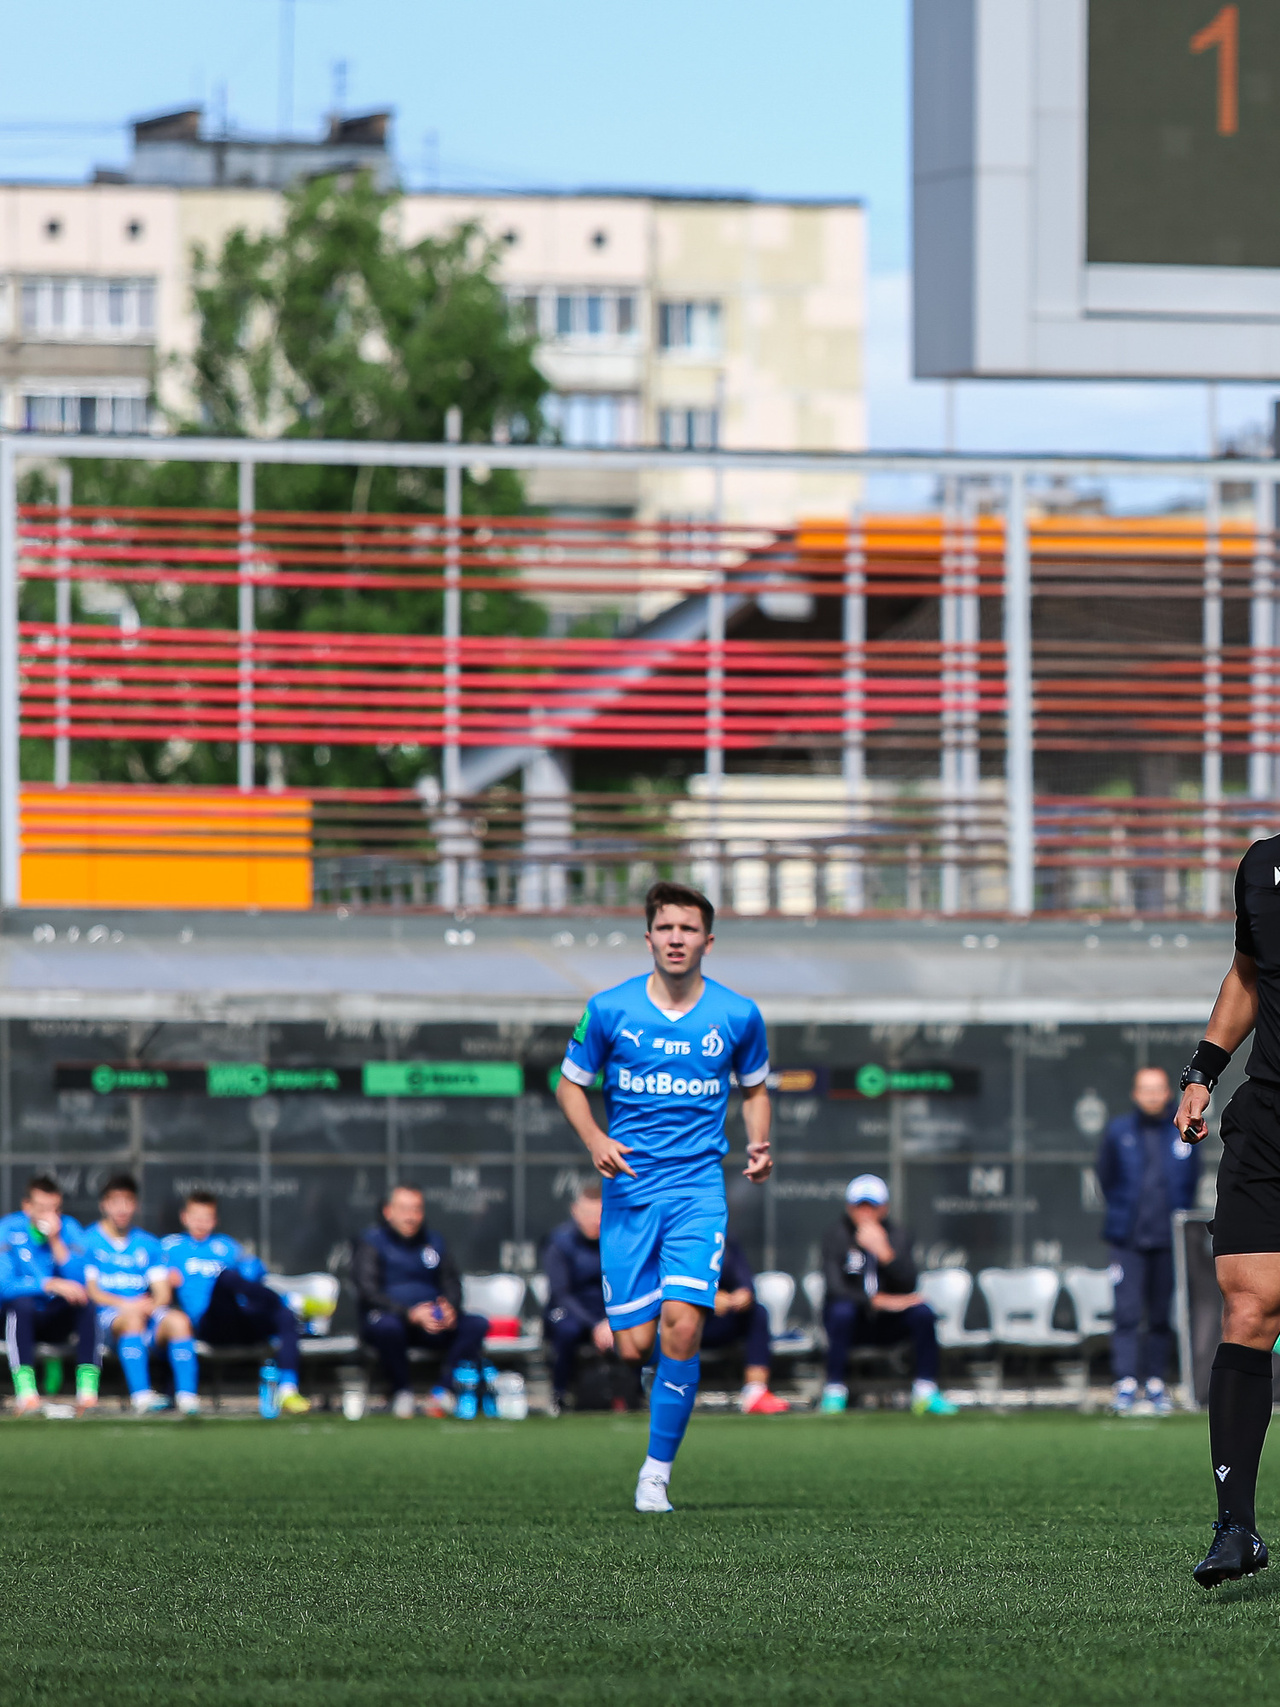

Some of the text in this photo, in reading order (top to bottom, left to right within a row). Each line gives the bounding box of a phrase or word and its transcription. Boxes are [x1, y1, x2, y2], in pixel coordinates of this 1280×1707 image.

[1190, 4, 1239, 136] 1
[663, 1040, 692, 1056] ВТБ
[617, 1067, 721, 1097] BetBoom
